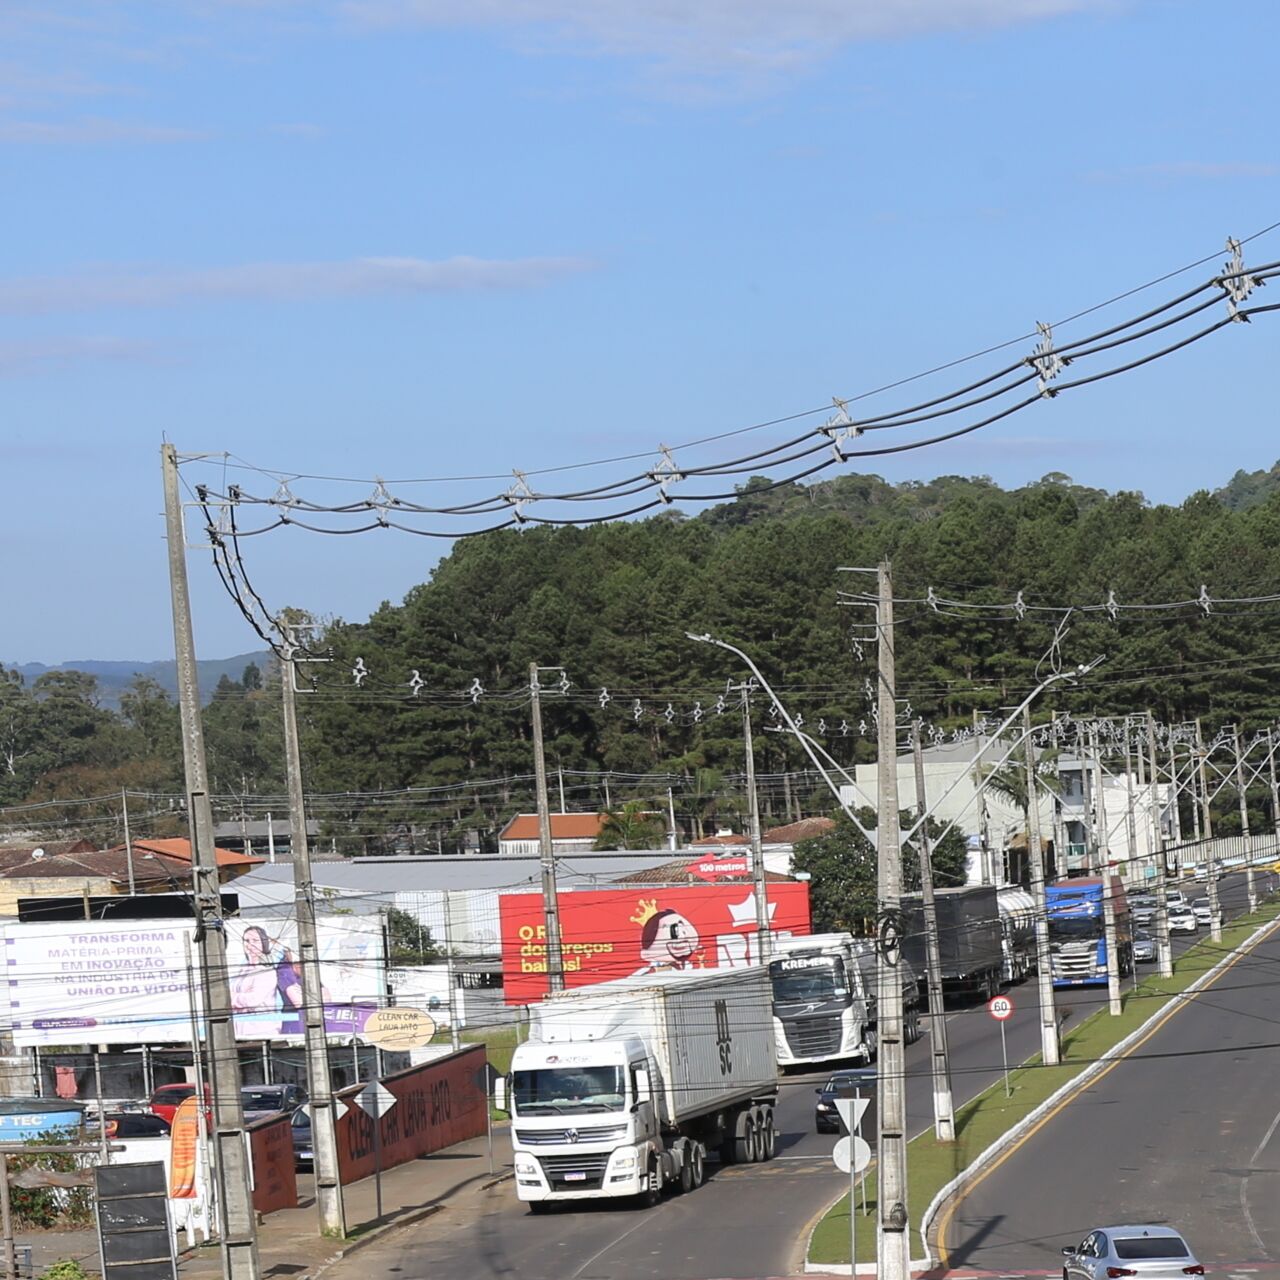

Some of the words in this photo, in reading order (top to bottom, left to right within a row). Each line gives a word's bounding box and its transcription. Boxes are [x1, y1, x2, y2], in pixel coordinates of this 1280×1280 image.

[699, 863, 714, 872] 100
[715, 863, 746, 871] metros
[519, 926, 534, 940] O
[537, 924, 563, 940] Ri
[69, 932, 175, 944] TRANSFORMA
[62, 962, 83, 970] EM
[87, 957, 165, 971] INOVAÇÃO
[67, 984, 115, 996] UNIÃO
[119, 985, 139, 995] DA
[145, 981, 205, 995] VITÓRA
[994, 1001, 1008, 1012] 60
[378, 1012, 402, 1022] CLEAN
[403, 1012, 419, 1021] CAR
[379, 1023, 399, 1032] LAVA
[400, 1023, 418, 1031] JATO
